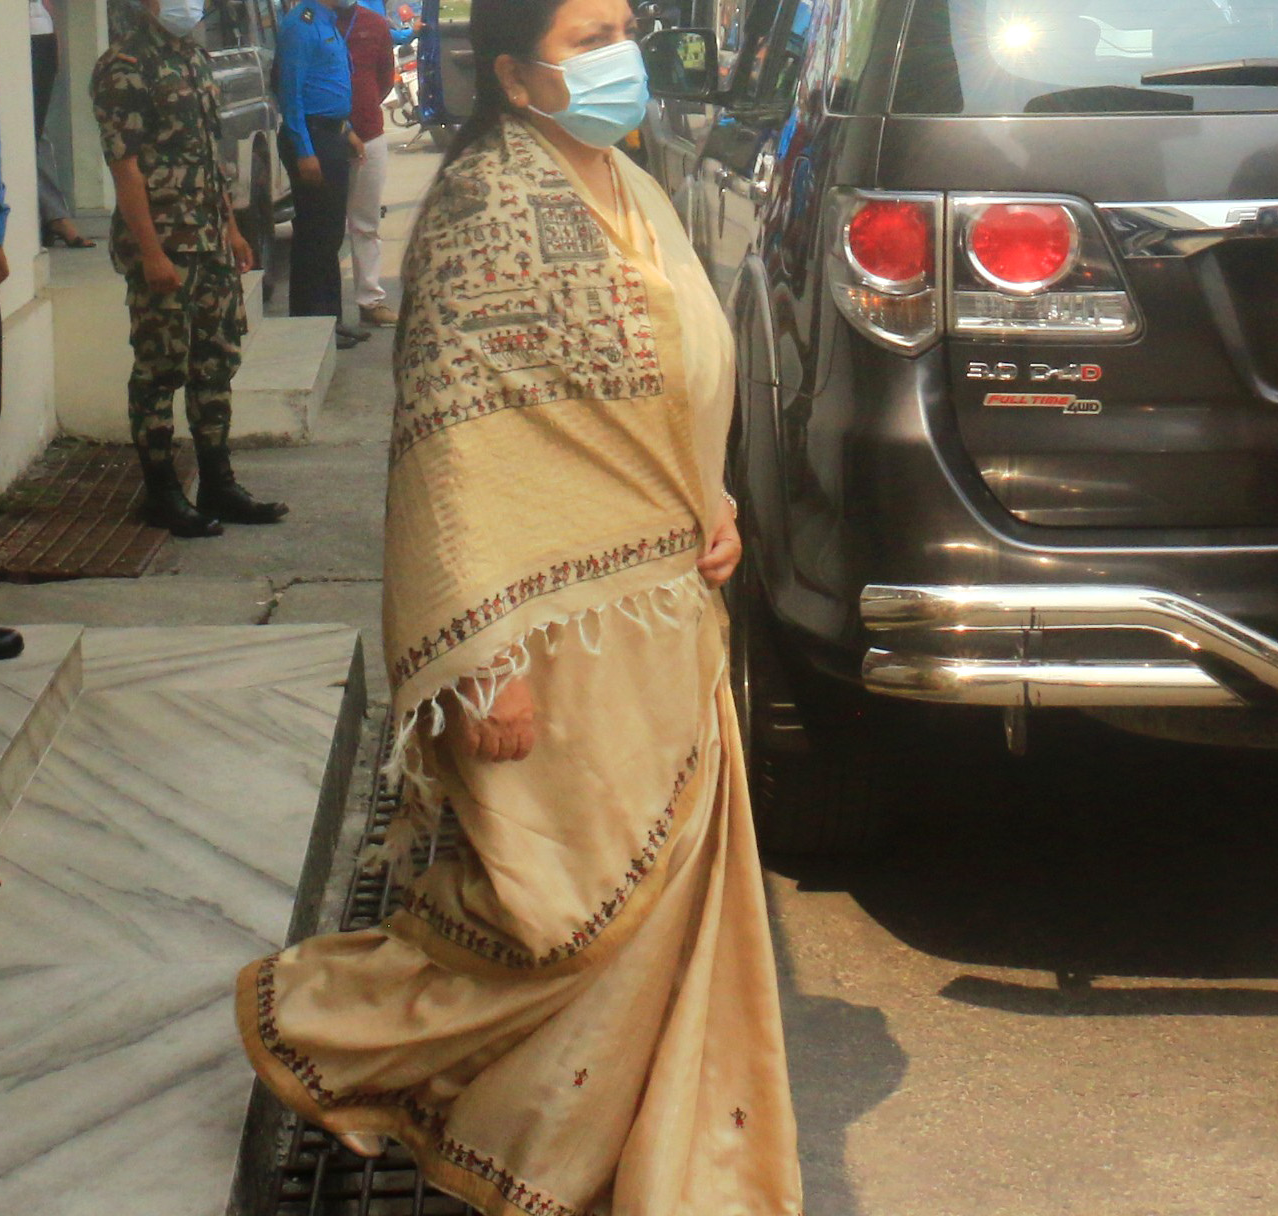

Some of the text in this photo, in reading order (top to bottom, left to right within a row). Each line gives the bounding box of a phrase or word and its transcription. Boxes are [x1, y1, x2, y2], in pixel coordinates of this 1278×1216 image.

[986, 395, 1100, 413] FULL TIME 4WD
